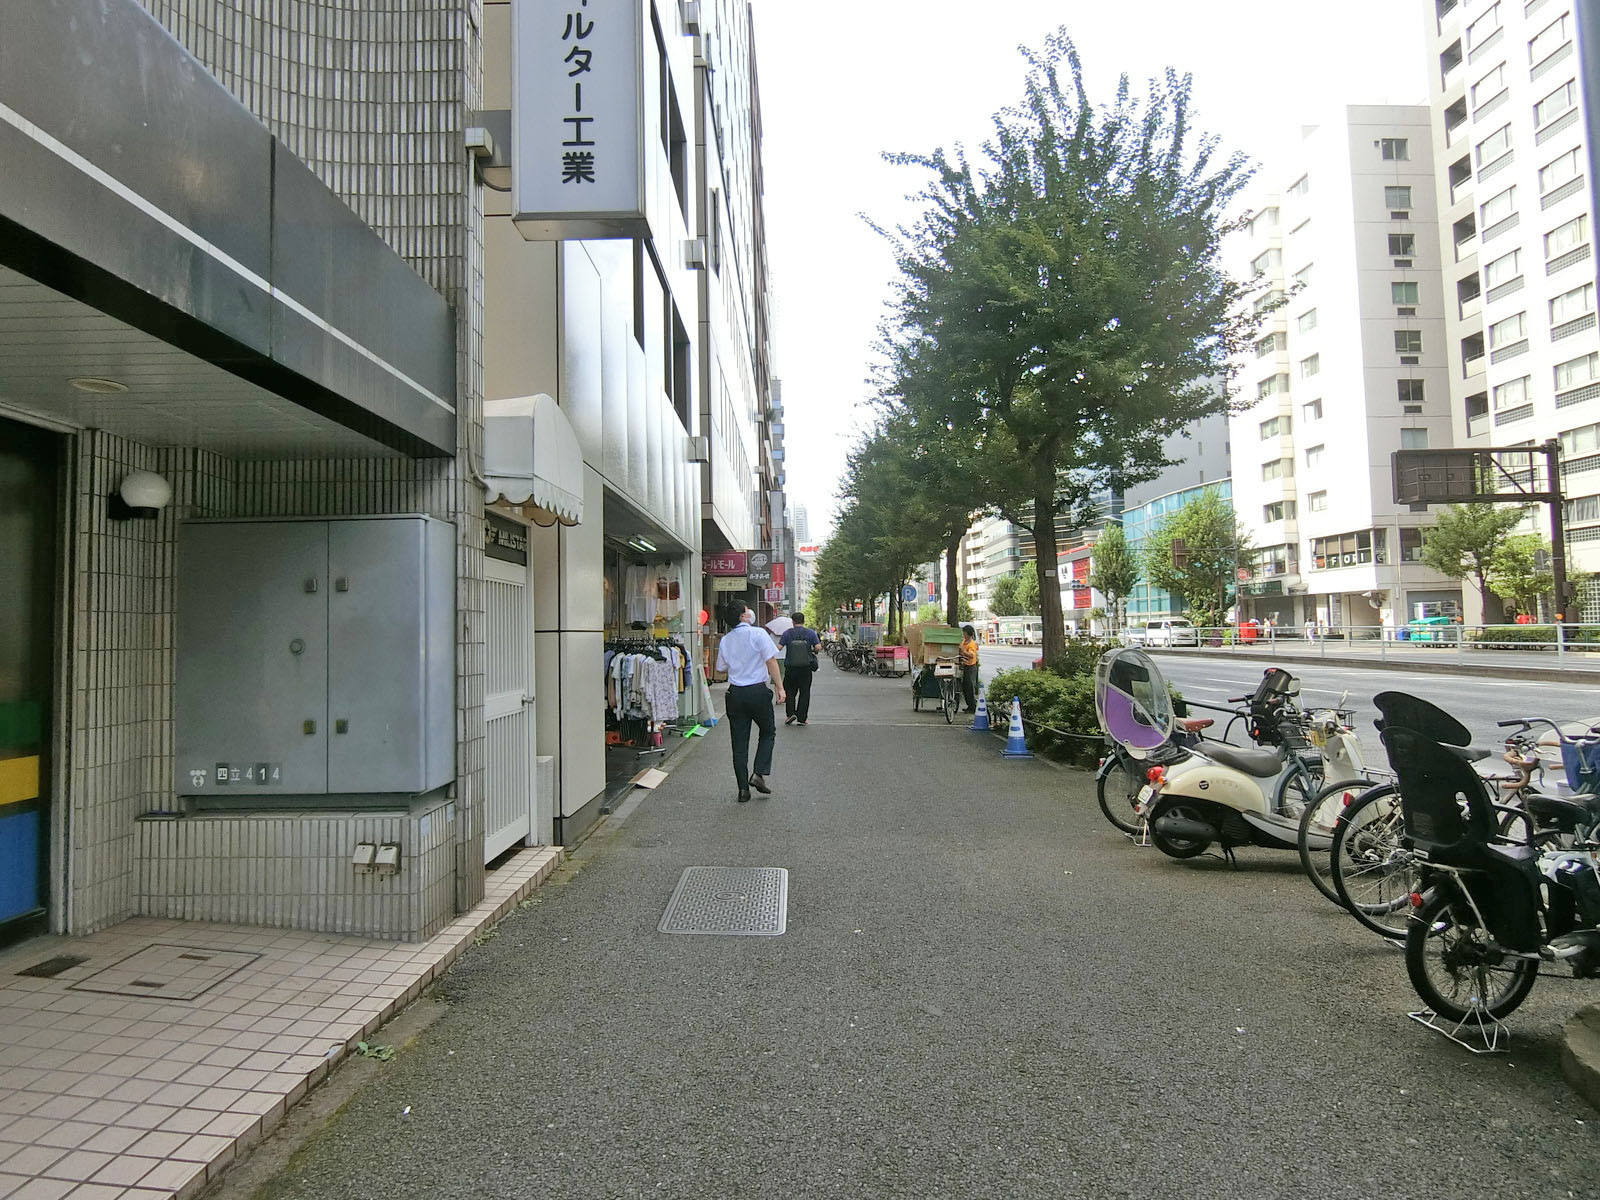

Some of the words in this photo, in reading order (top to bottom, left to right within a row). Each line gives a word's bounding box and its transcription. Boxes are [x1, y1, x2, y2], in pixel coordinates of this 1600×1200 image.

[562, 0, 595, 184] ルター工業
[905, 589, 912, 601] P
[217, 767, 280, 781] 四立414
